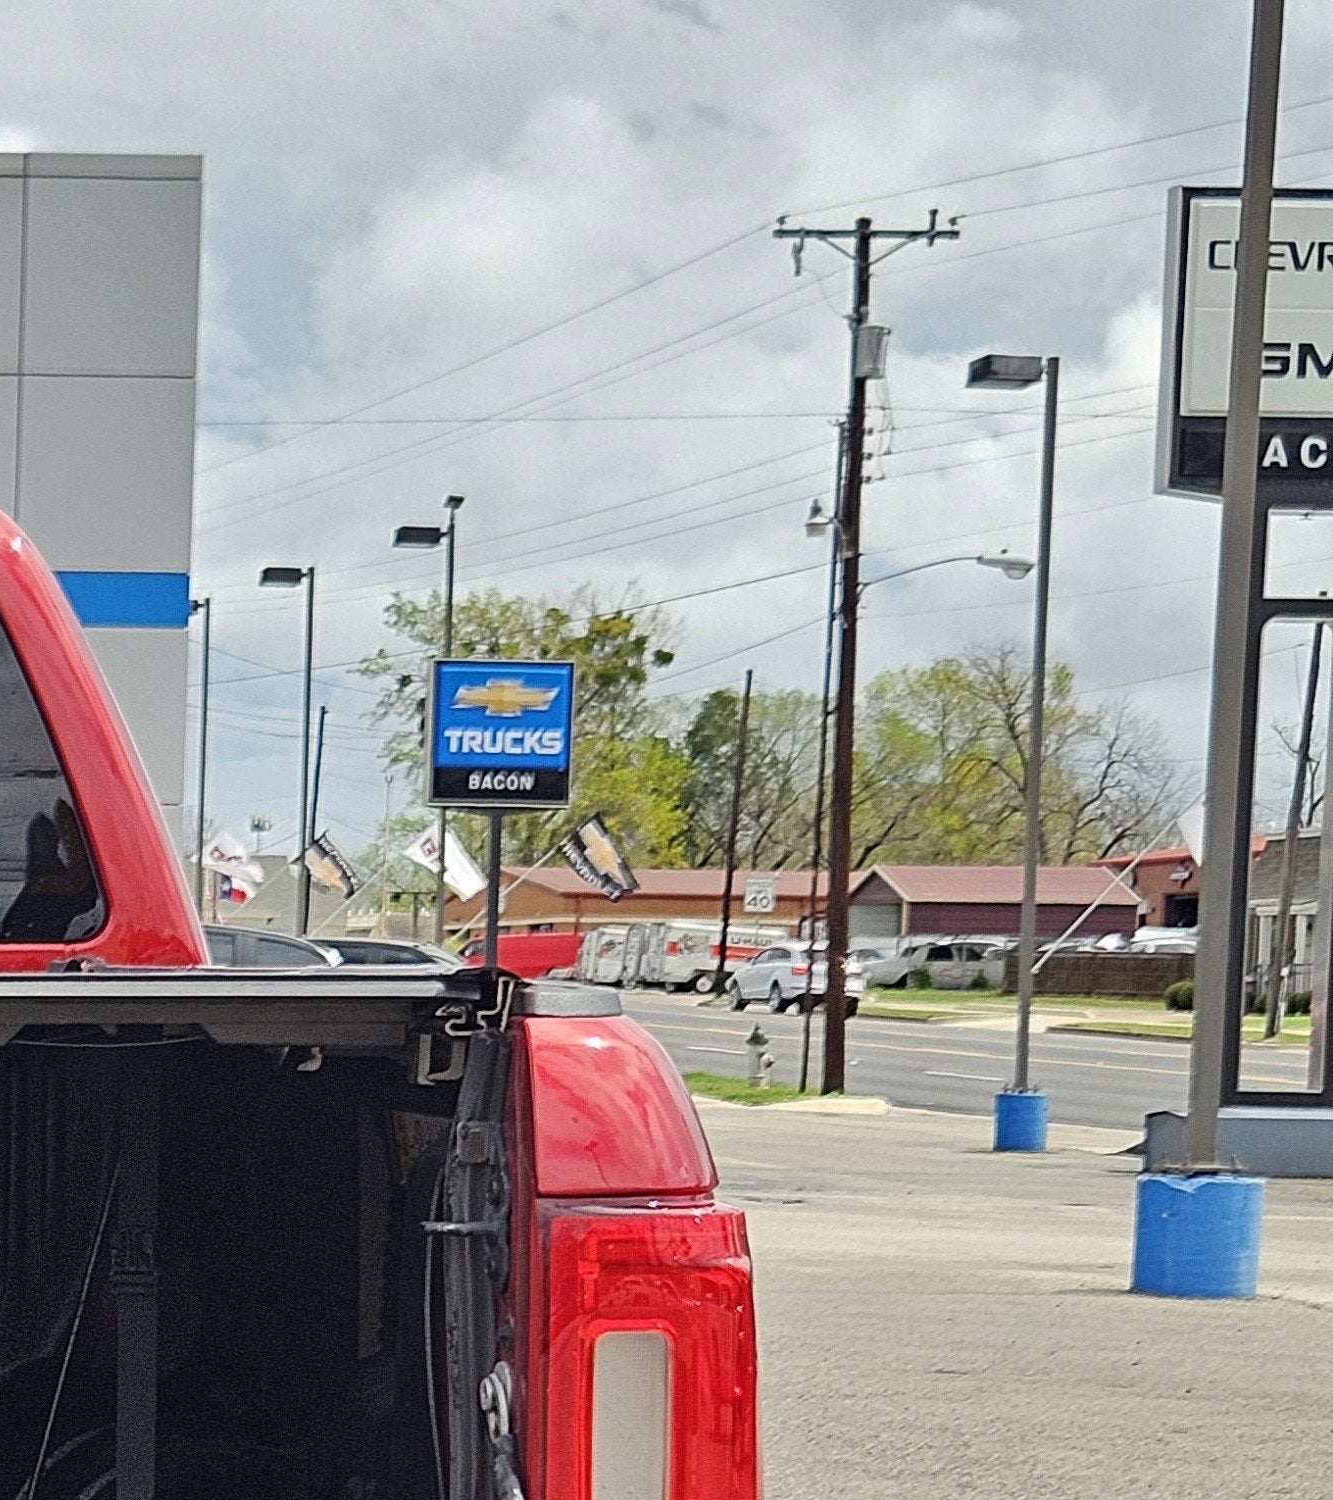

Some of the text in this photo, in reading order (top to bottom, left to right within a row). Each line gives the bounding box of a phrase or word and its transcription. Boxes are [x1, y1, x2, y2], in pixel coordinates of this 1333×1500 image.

[1208, 239, 1333, 271] CEVR
[1261, 435, 1329, 469] AC
[443, 728, 565, 755] TRUCKS
[468, 771, 535, 791] BACON
[746, 896, 770, 909] 40
